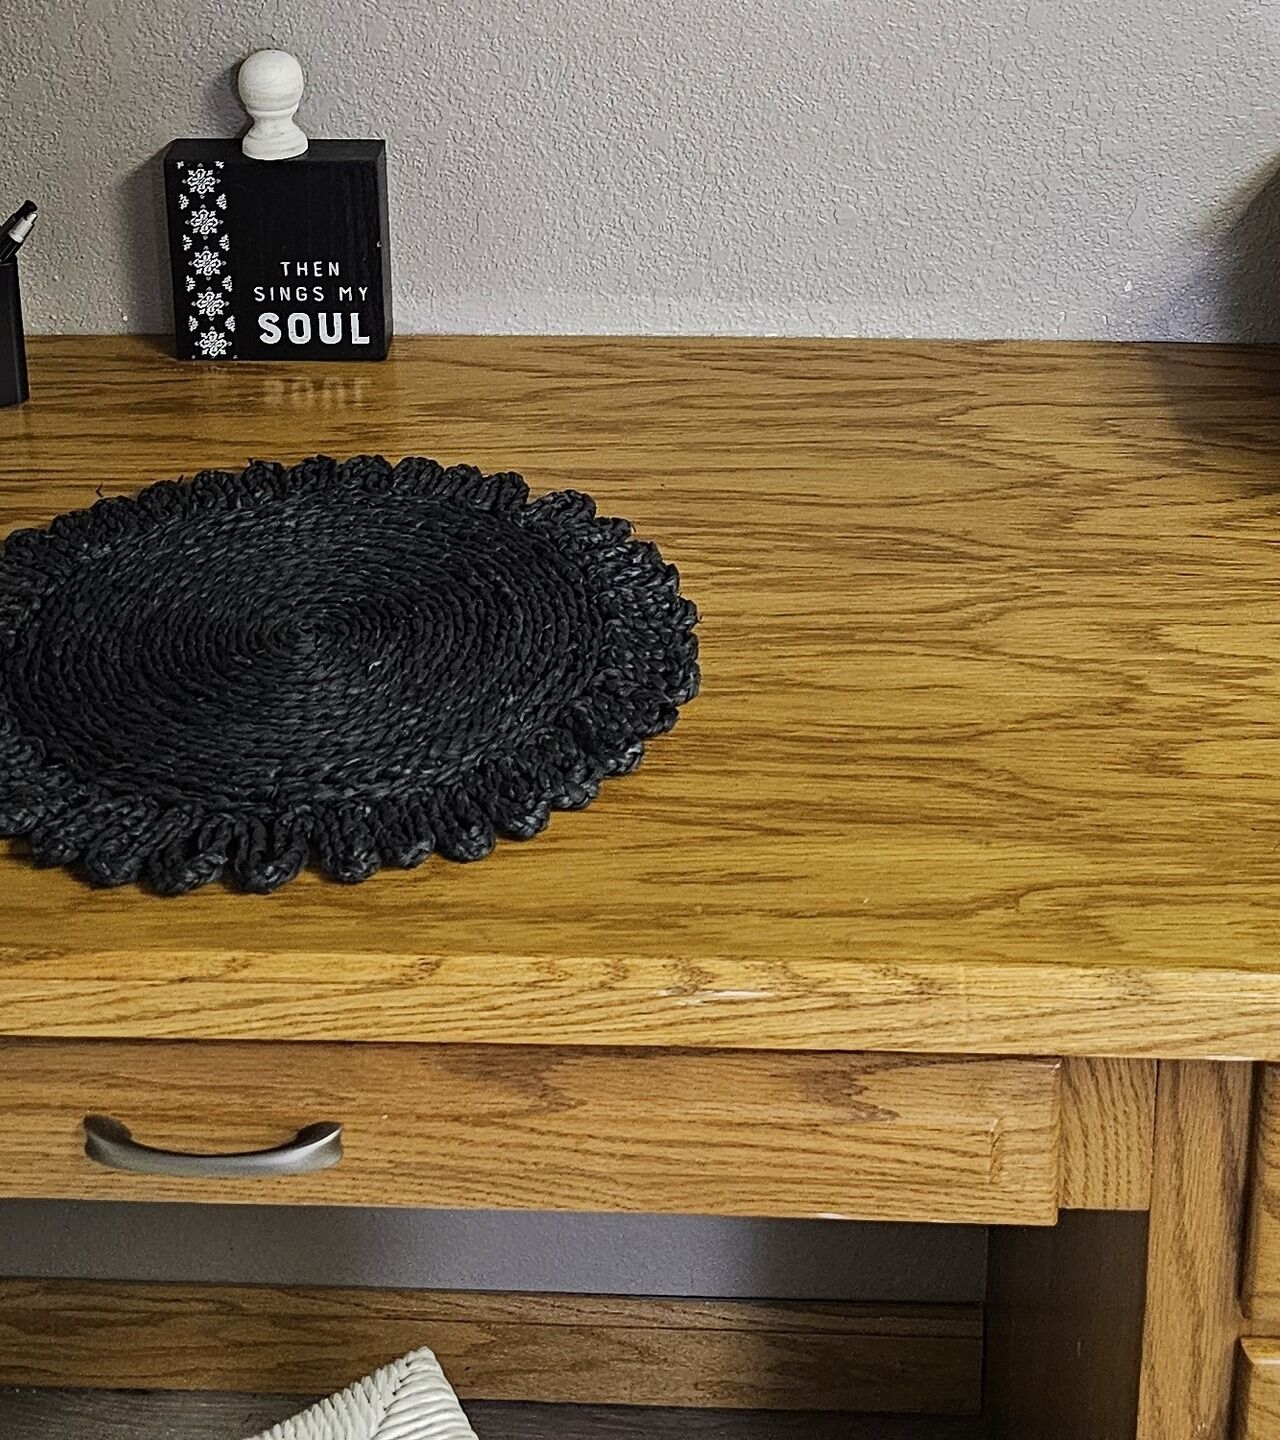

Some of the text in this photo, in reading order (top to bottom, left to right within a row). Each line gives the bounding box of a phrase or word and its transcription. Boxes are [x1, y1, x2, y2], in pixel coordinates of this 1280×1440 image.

[280, 261, 340, 277] THEN
[253, 286, 368, 302] SINGS MY
[257, 312, 370, 344] SOUL
